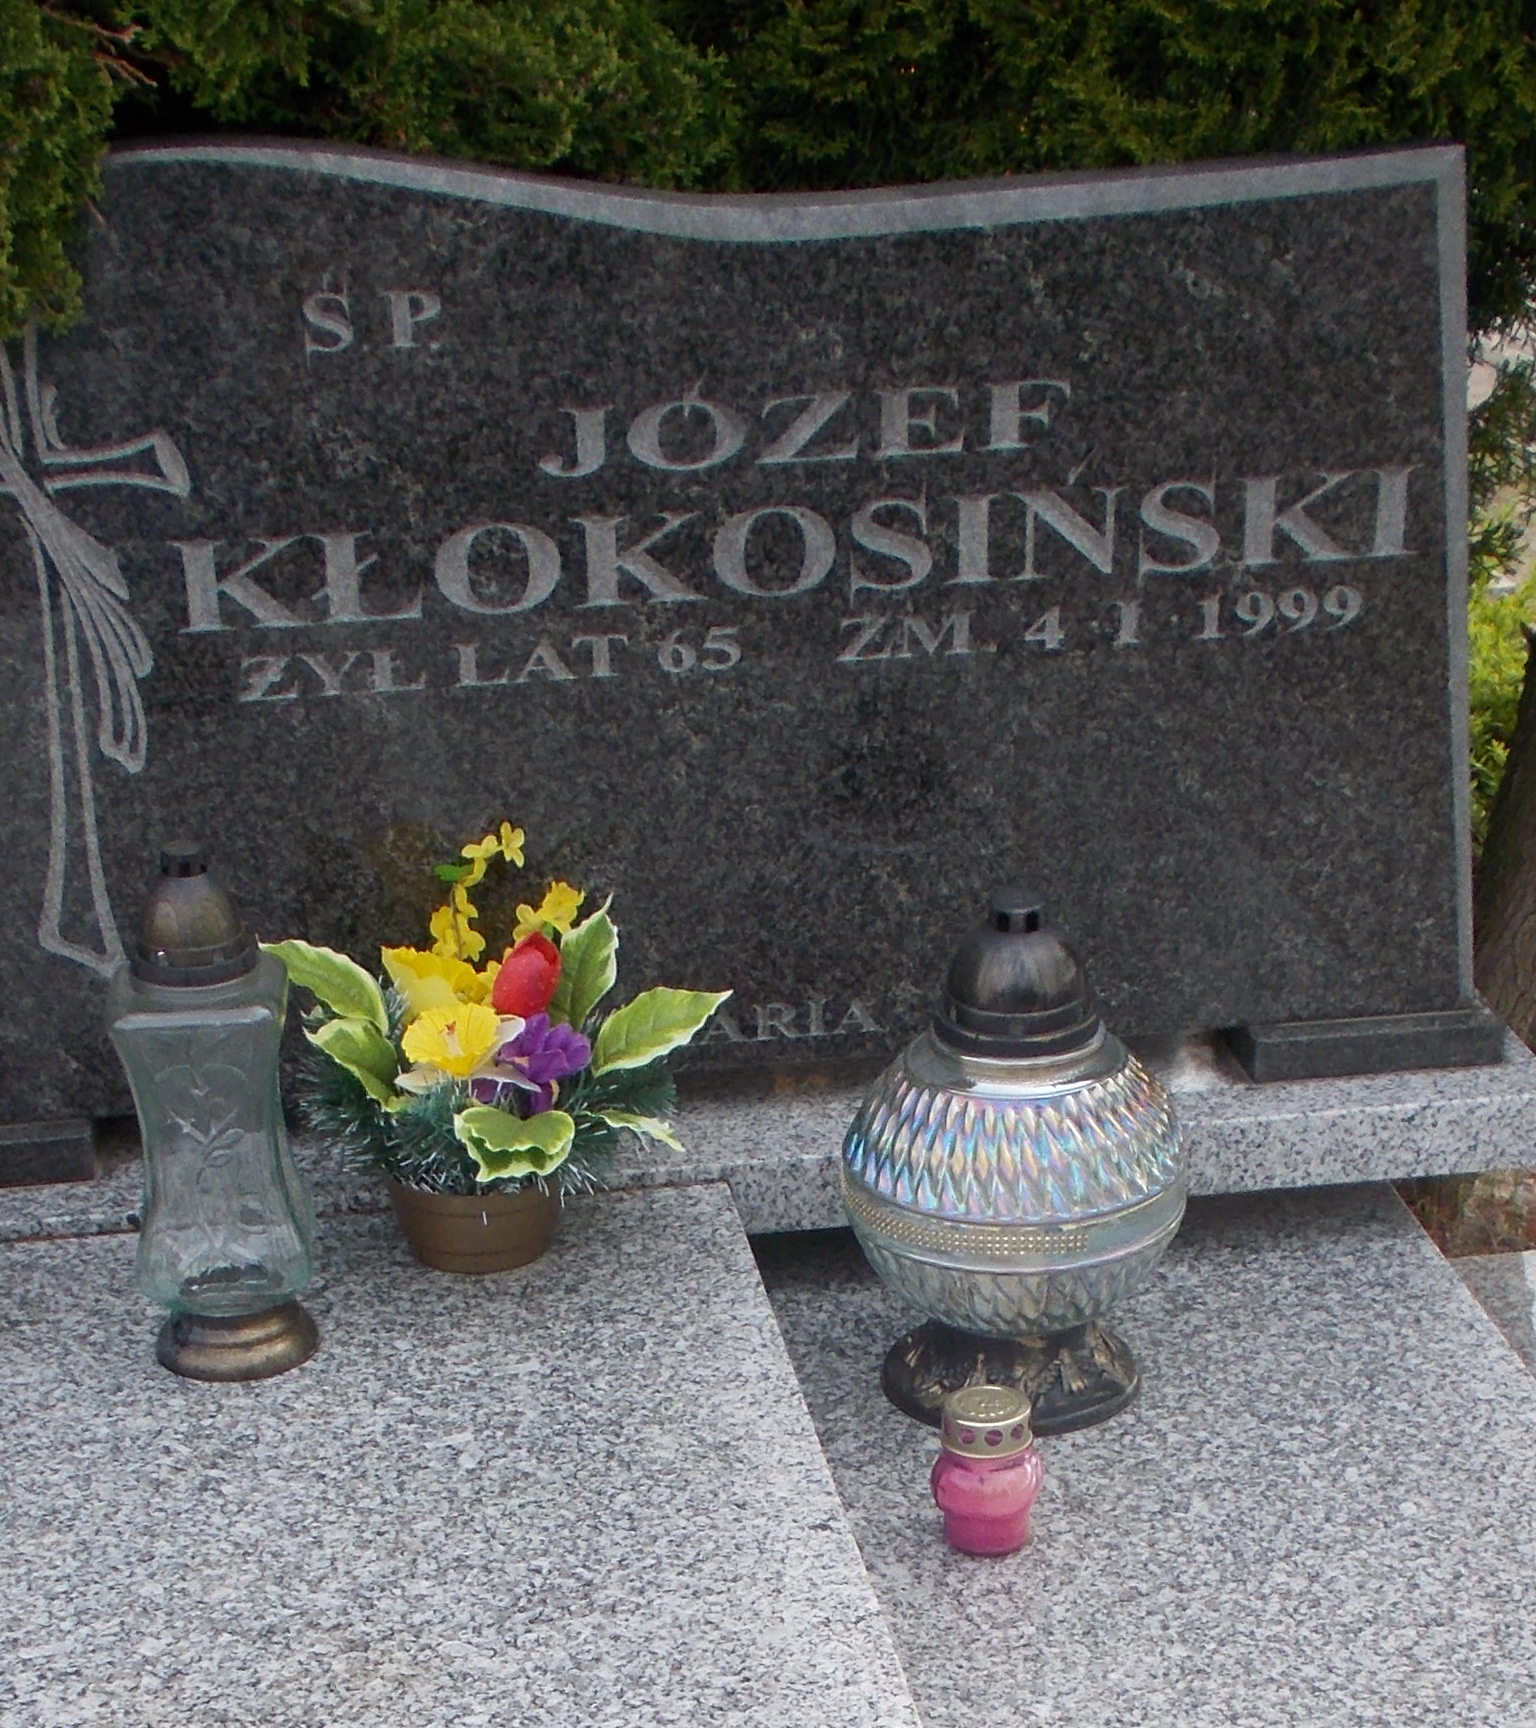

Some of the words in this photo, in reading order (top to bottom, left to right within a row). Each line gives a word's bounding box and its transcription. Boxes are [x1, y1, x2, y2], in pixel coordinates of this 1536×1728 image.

[539, 373, 1071, 478] JÓZEF
[166, 447, 1424, 634] KŁOKOSIŃSKI
[453, 633, 629, 688] LAT
[657, 624, 742, 673] 65
[698, 997, 890, 1047] ARIA
